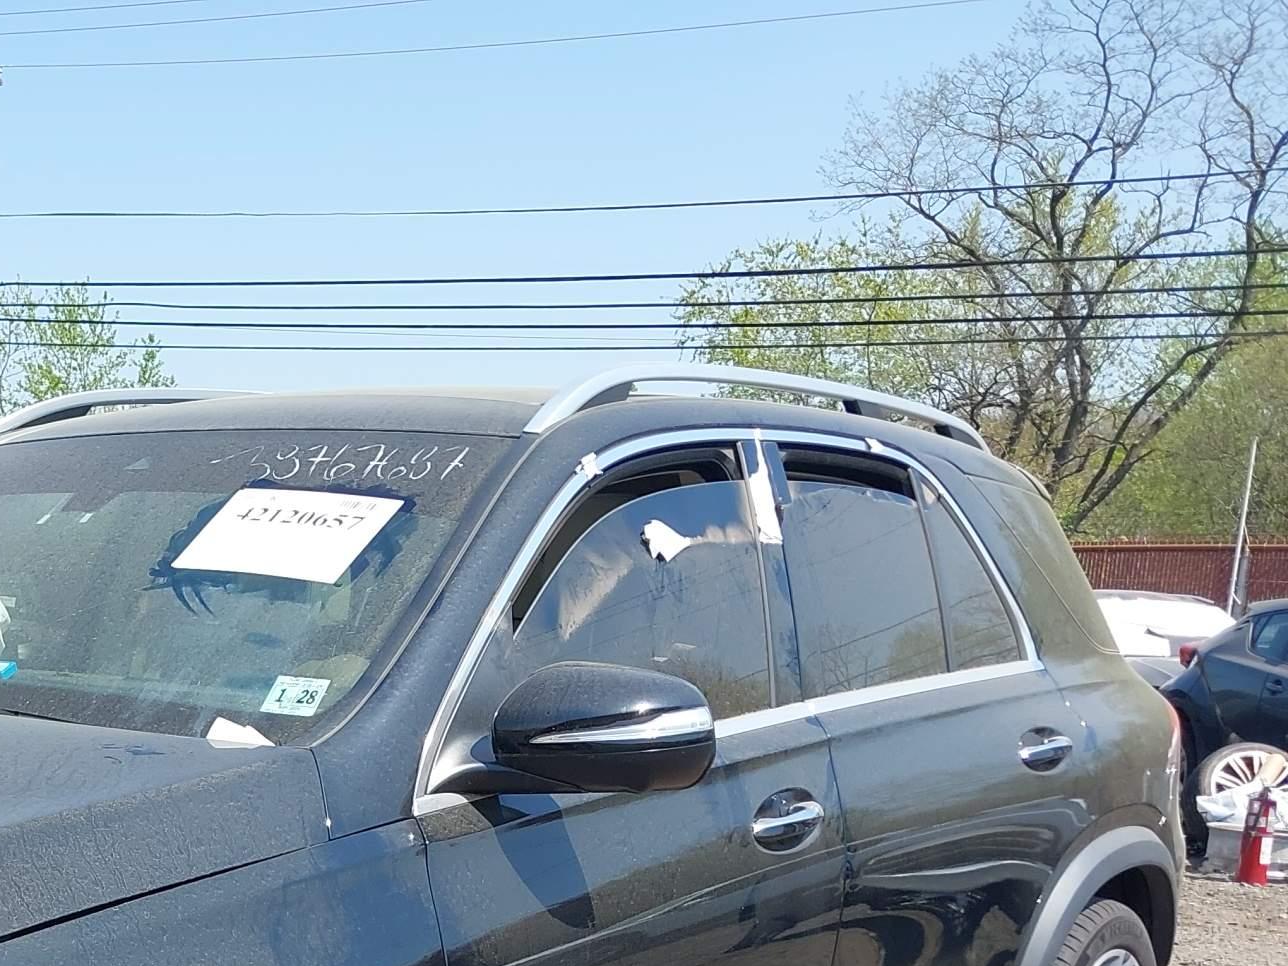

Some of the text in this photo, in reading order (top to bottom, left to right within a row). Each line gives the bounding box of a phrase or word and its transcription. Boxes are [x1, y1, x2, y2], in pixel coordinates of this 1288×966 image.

[236, 507, 366, 531] 42120657
[274, 687, 319, 705] 1 28
